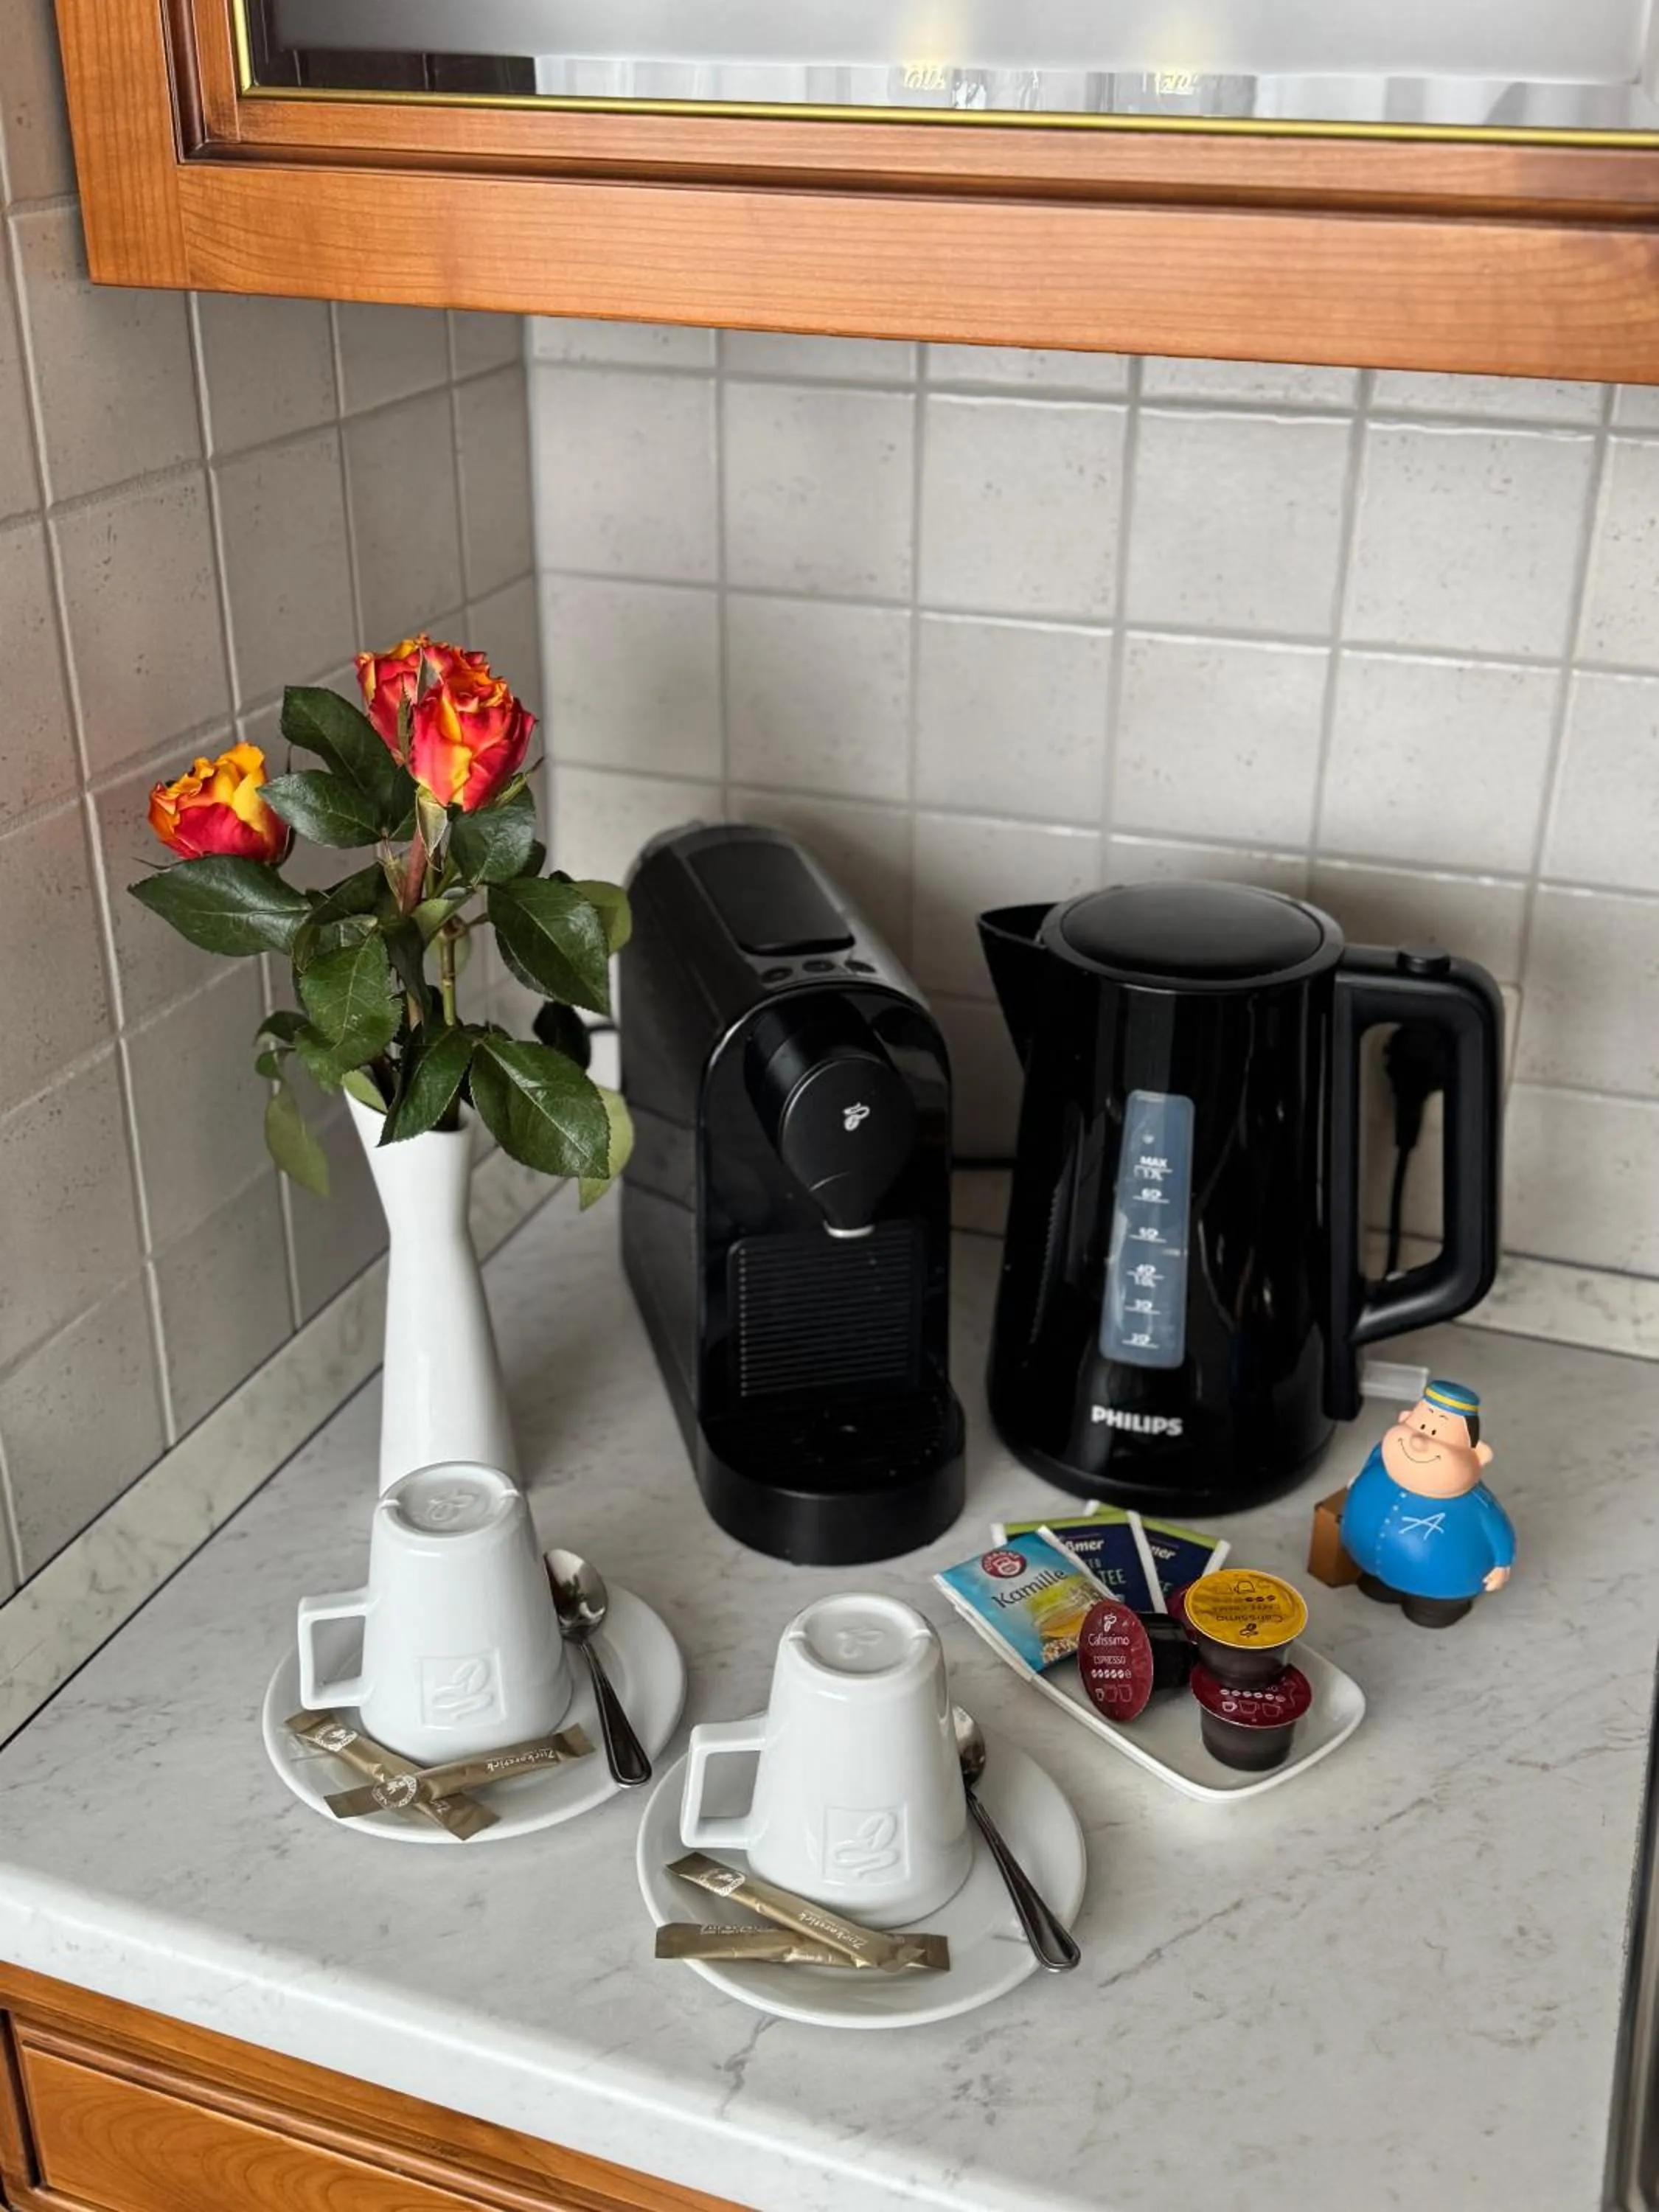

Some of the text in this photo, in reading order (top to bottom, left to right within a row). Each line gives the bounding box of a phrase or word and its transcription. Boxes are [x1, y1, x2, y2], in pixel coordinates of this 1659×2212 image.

[1140, 1156, 1168, 1169] MAX
[1091, 1405, 1183, 1436] PHILIPS
[991, 1569, 1068, 1608] Kamille
[1088, 1632, 1130, 1646] Cafissimo
[1093, 1655, 1127, 1665] ESPRESSO
